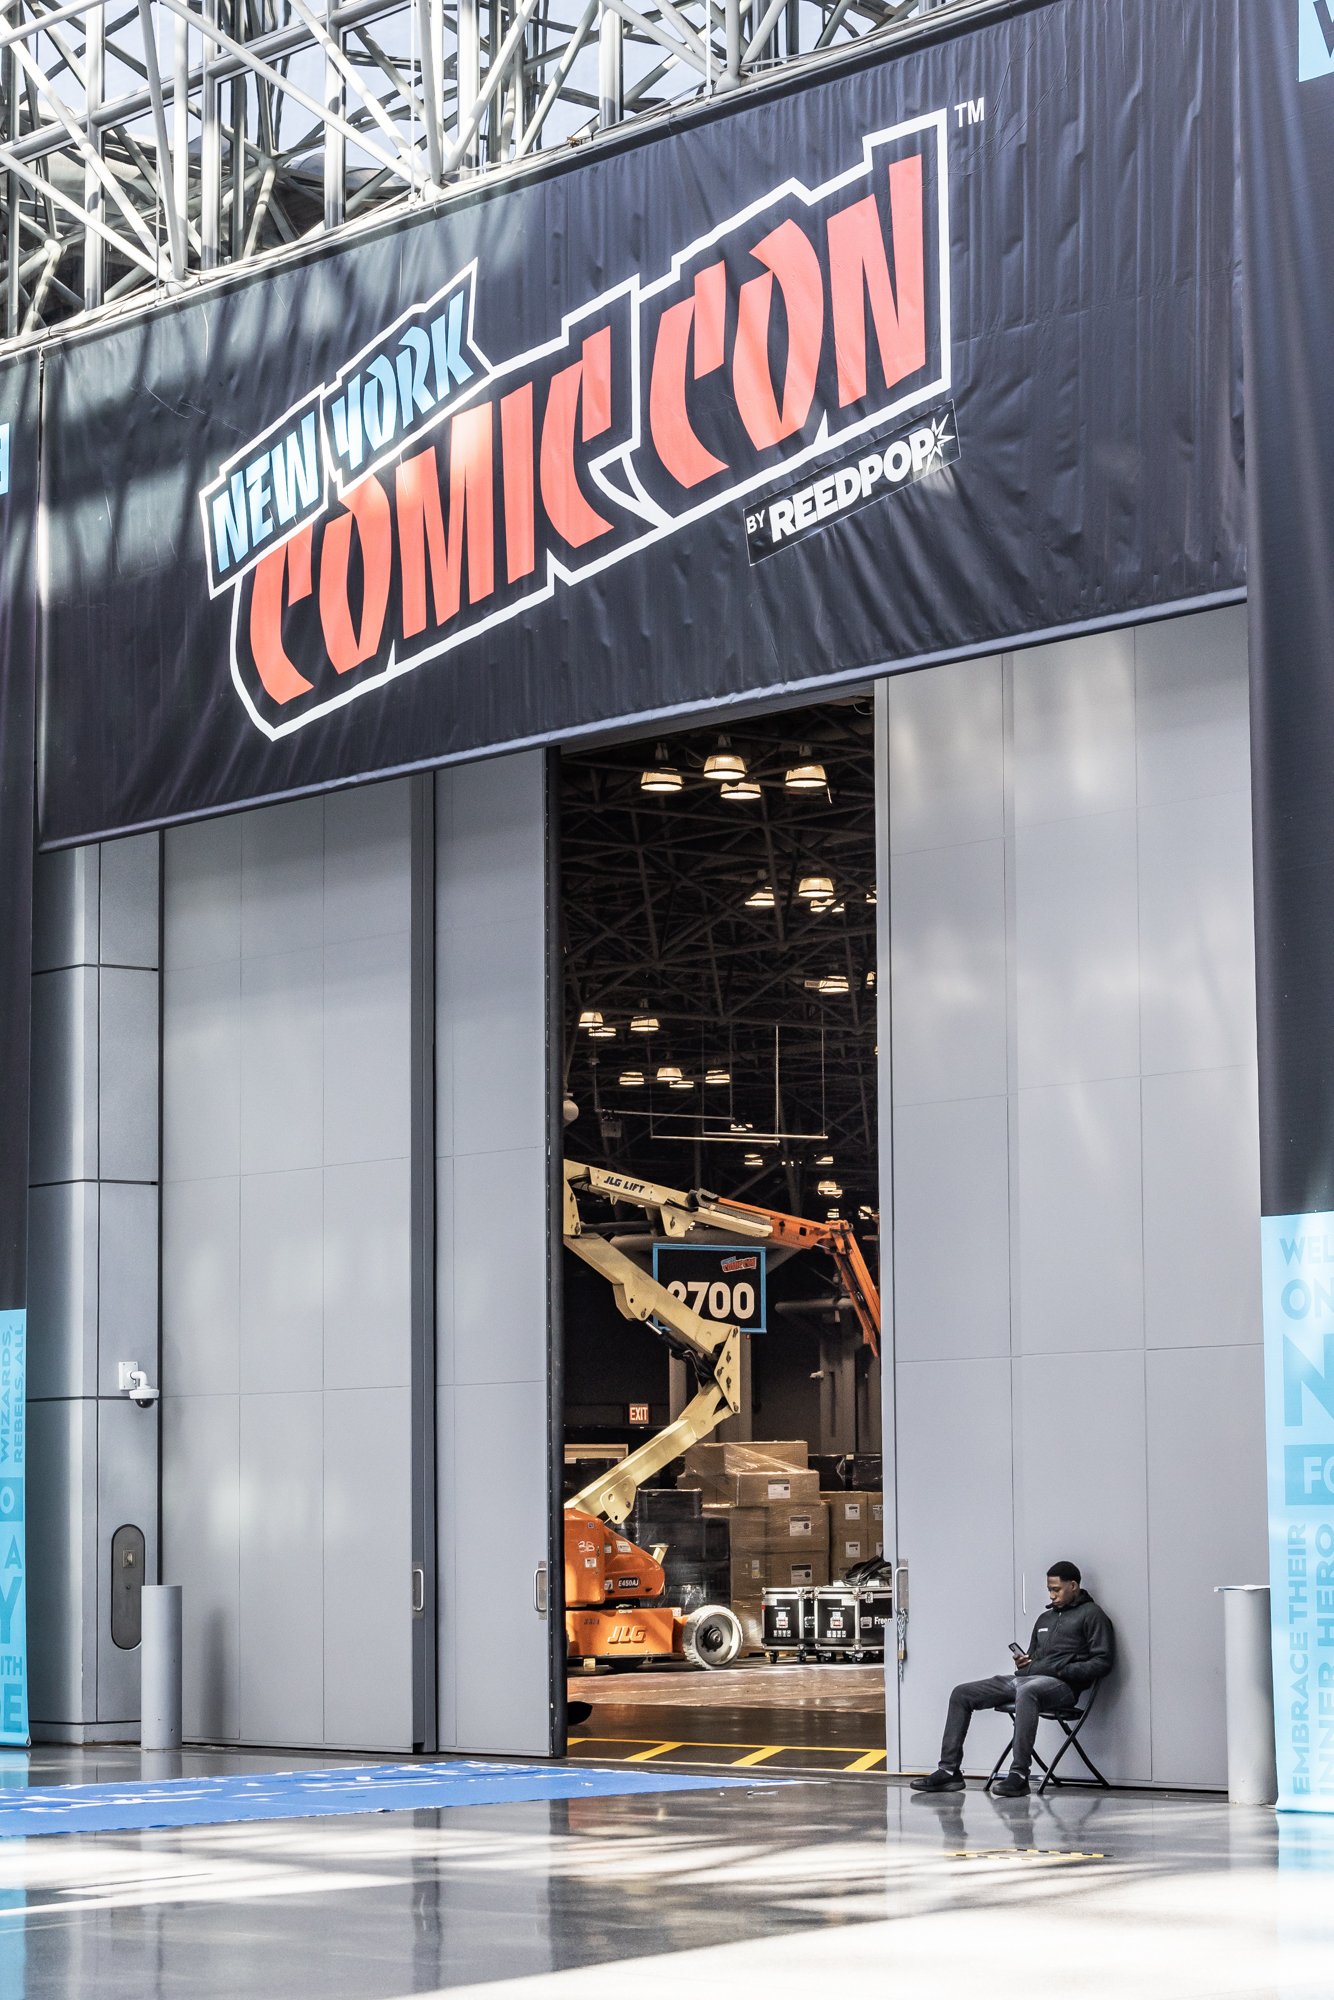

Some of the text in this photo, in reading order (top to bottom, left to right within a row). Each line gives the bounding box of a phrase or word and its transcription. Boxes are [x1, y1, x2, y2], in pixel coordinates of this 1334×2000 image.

[954, 97, 985, 128] TM
[211, 290, 474, 573] NEW YORK
[250, 154, 926, 705] COMIC CON
[746, 427, 933, 543] BY REEDPOP
[603, 1176, 645, 1193] JLG LIFT
[629, 1405, 648, 1422] EXIT
[608, 1625, 647, 1644] JLG
[1287, 1523, 1311, 1796] EMBRACE THEIR
